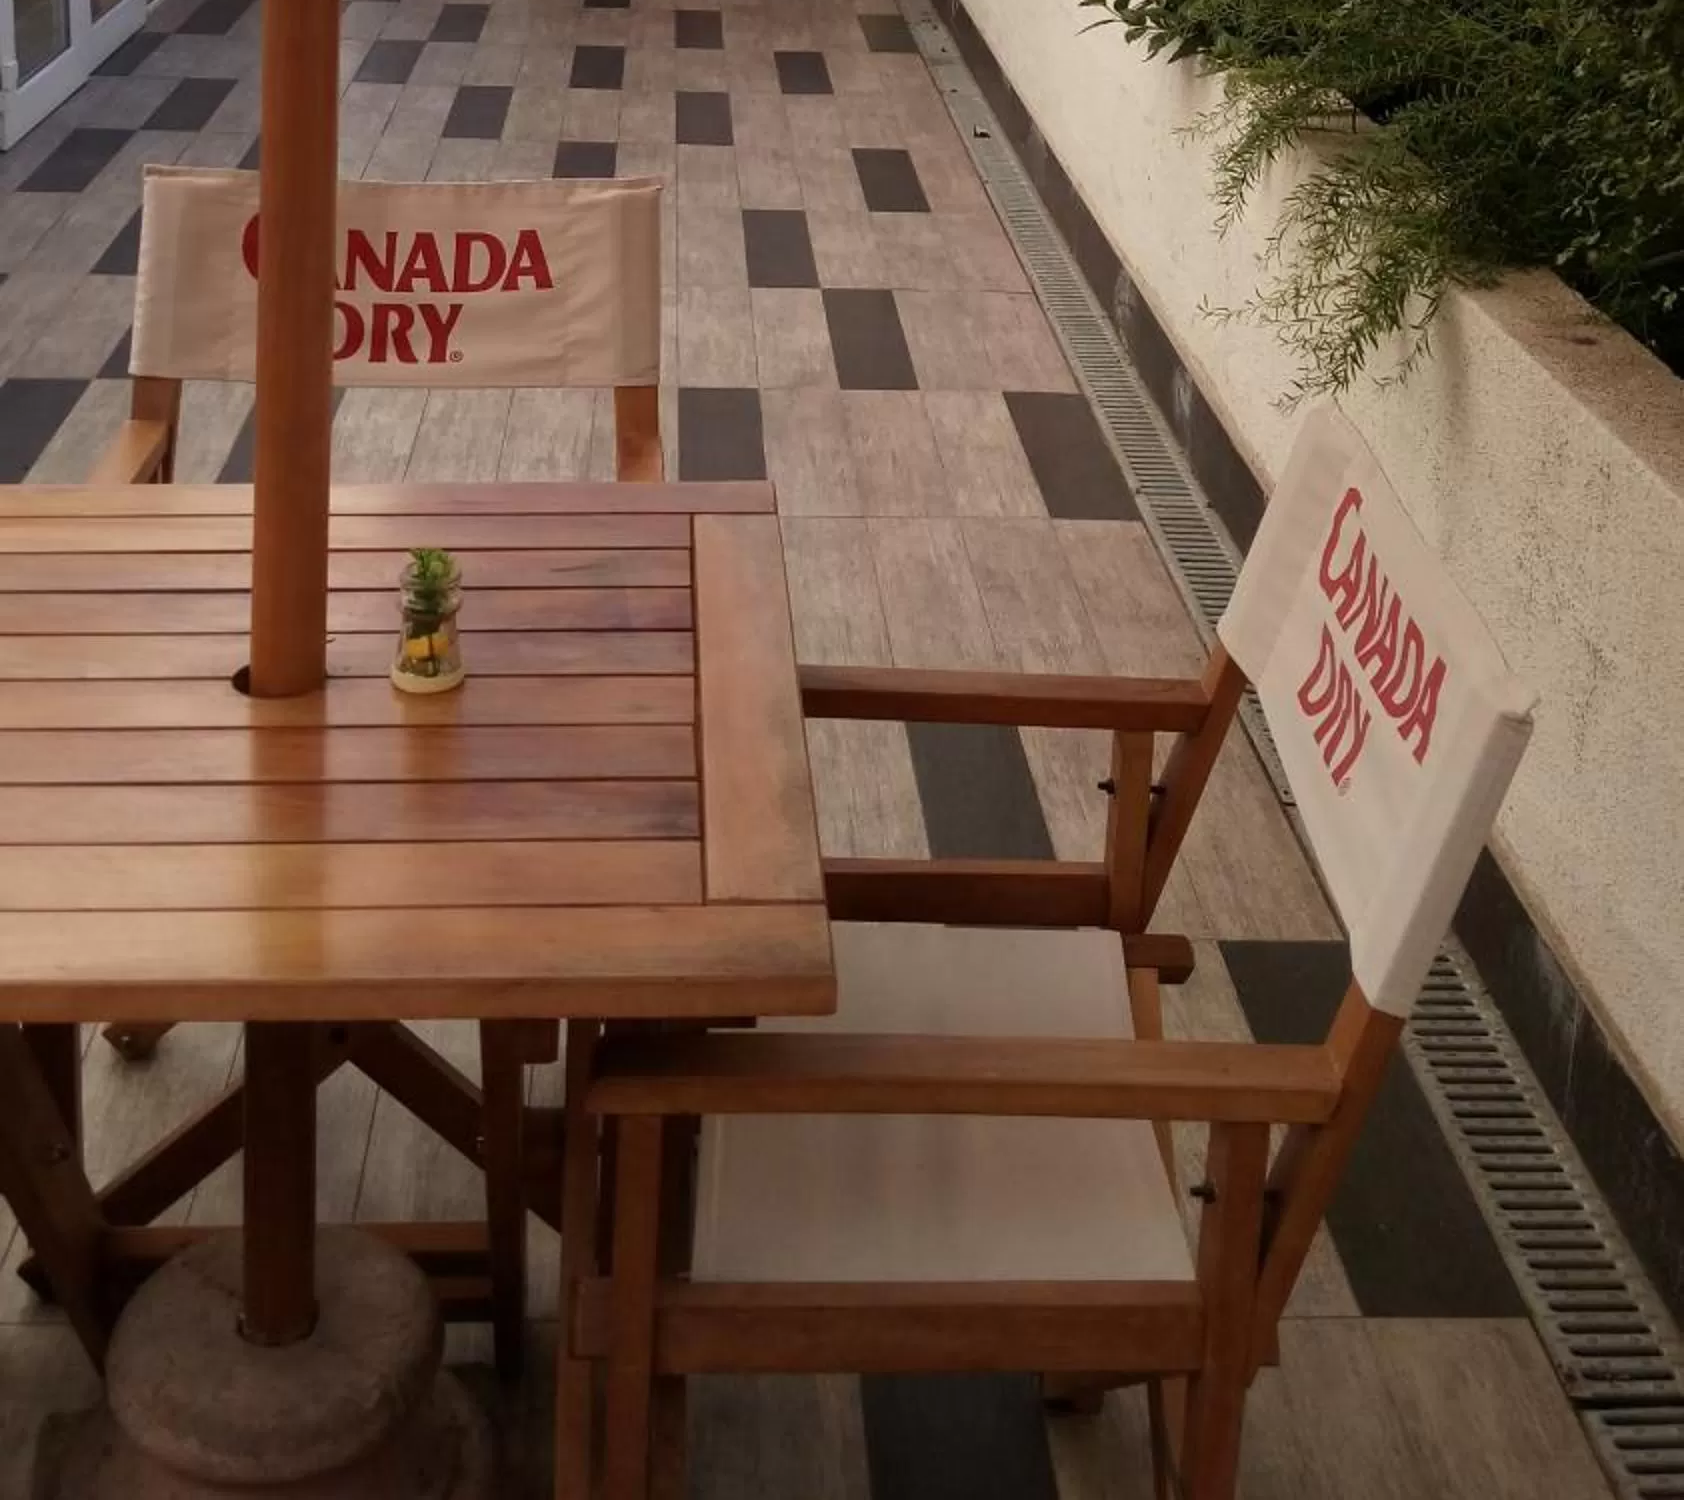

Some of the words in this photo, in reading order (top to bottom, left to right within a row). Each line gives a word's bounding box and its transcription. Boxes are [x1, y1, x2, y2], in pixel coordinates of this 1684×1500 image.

[241, 212, 554, 293] NADA
[1297, 621, 1371, 788] DRY
[1319, 487, 1447, 767] CANADA
